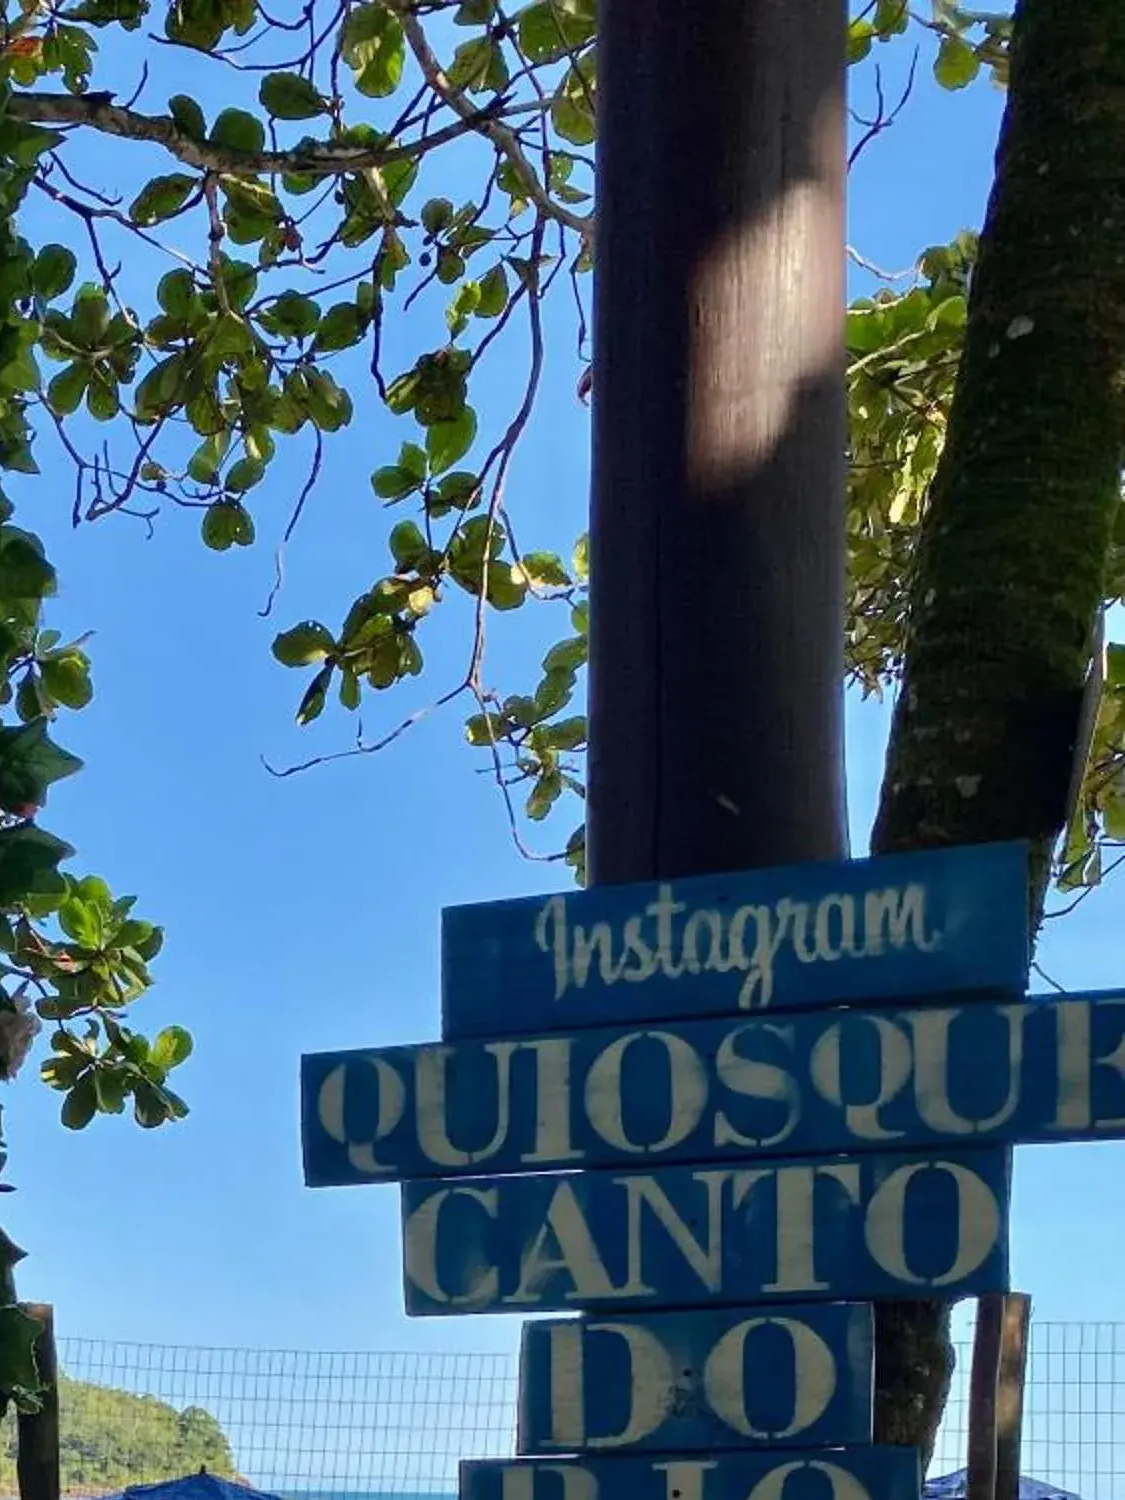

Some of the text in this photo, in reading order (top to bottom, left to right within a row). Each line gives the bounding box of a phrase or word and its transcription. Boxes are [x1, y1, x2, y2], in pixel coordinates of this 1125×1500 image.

[535, 884, 938, 1008] Instagram
[407, 1161, 1000, 1303] CANTO
[539, 1317, 836, 1448] DO
